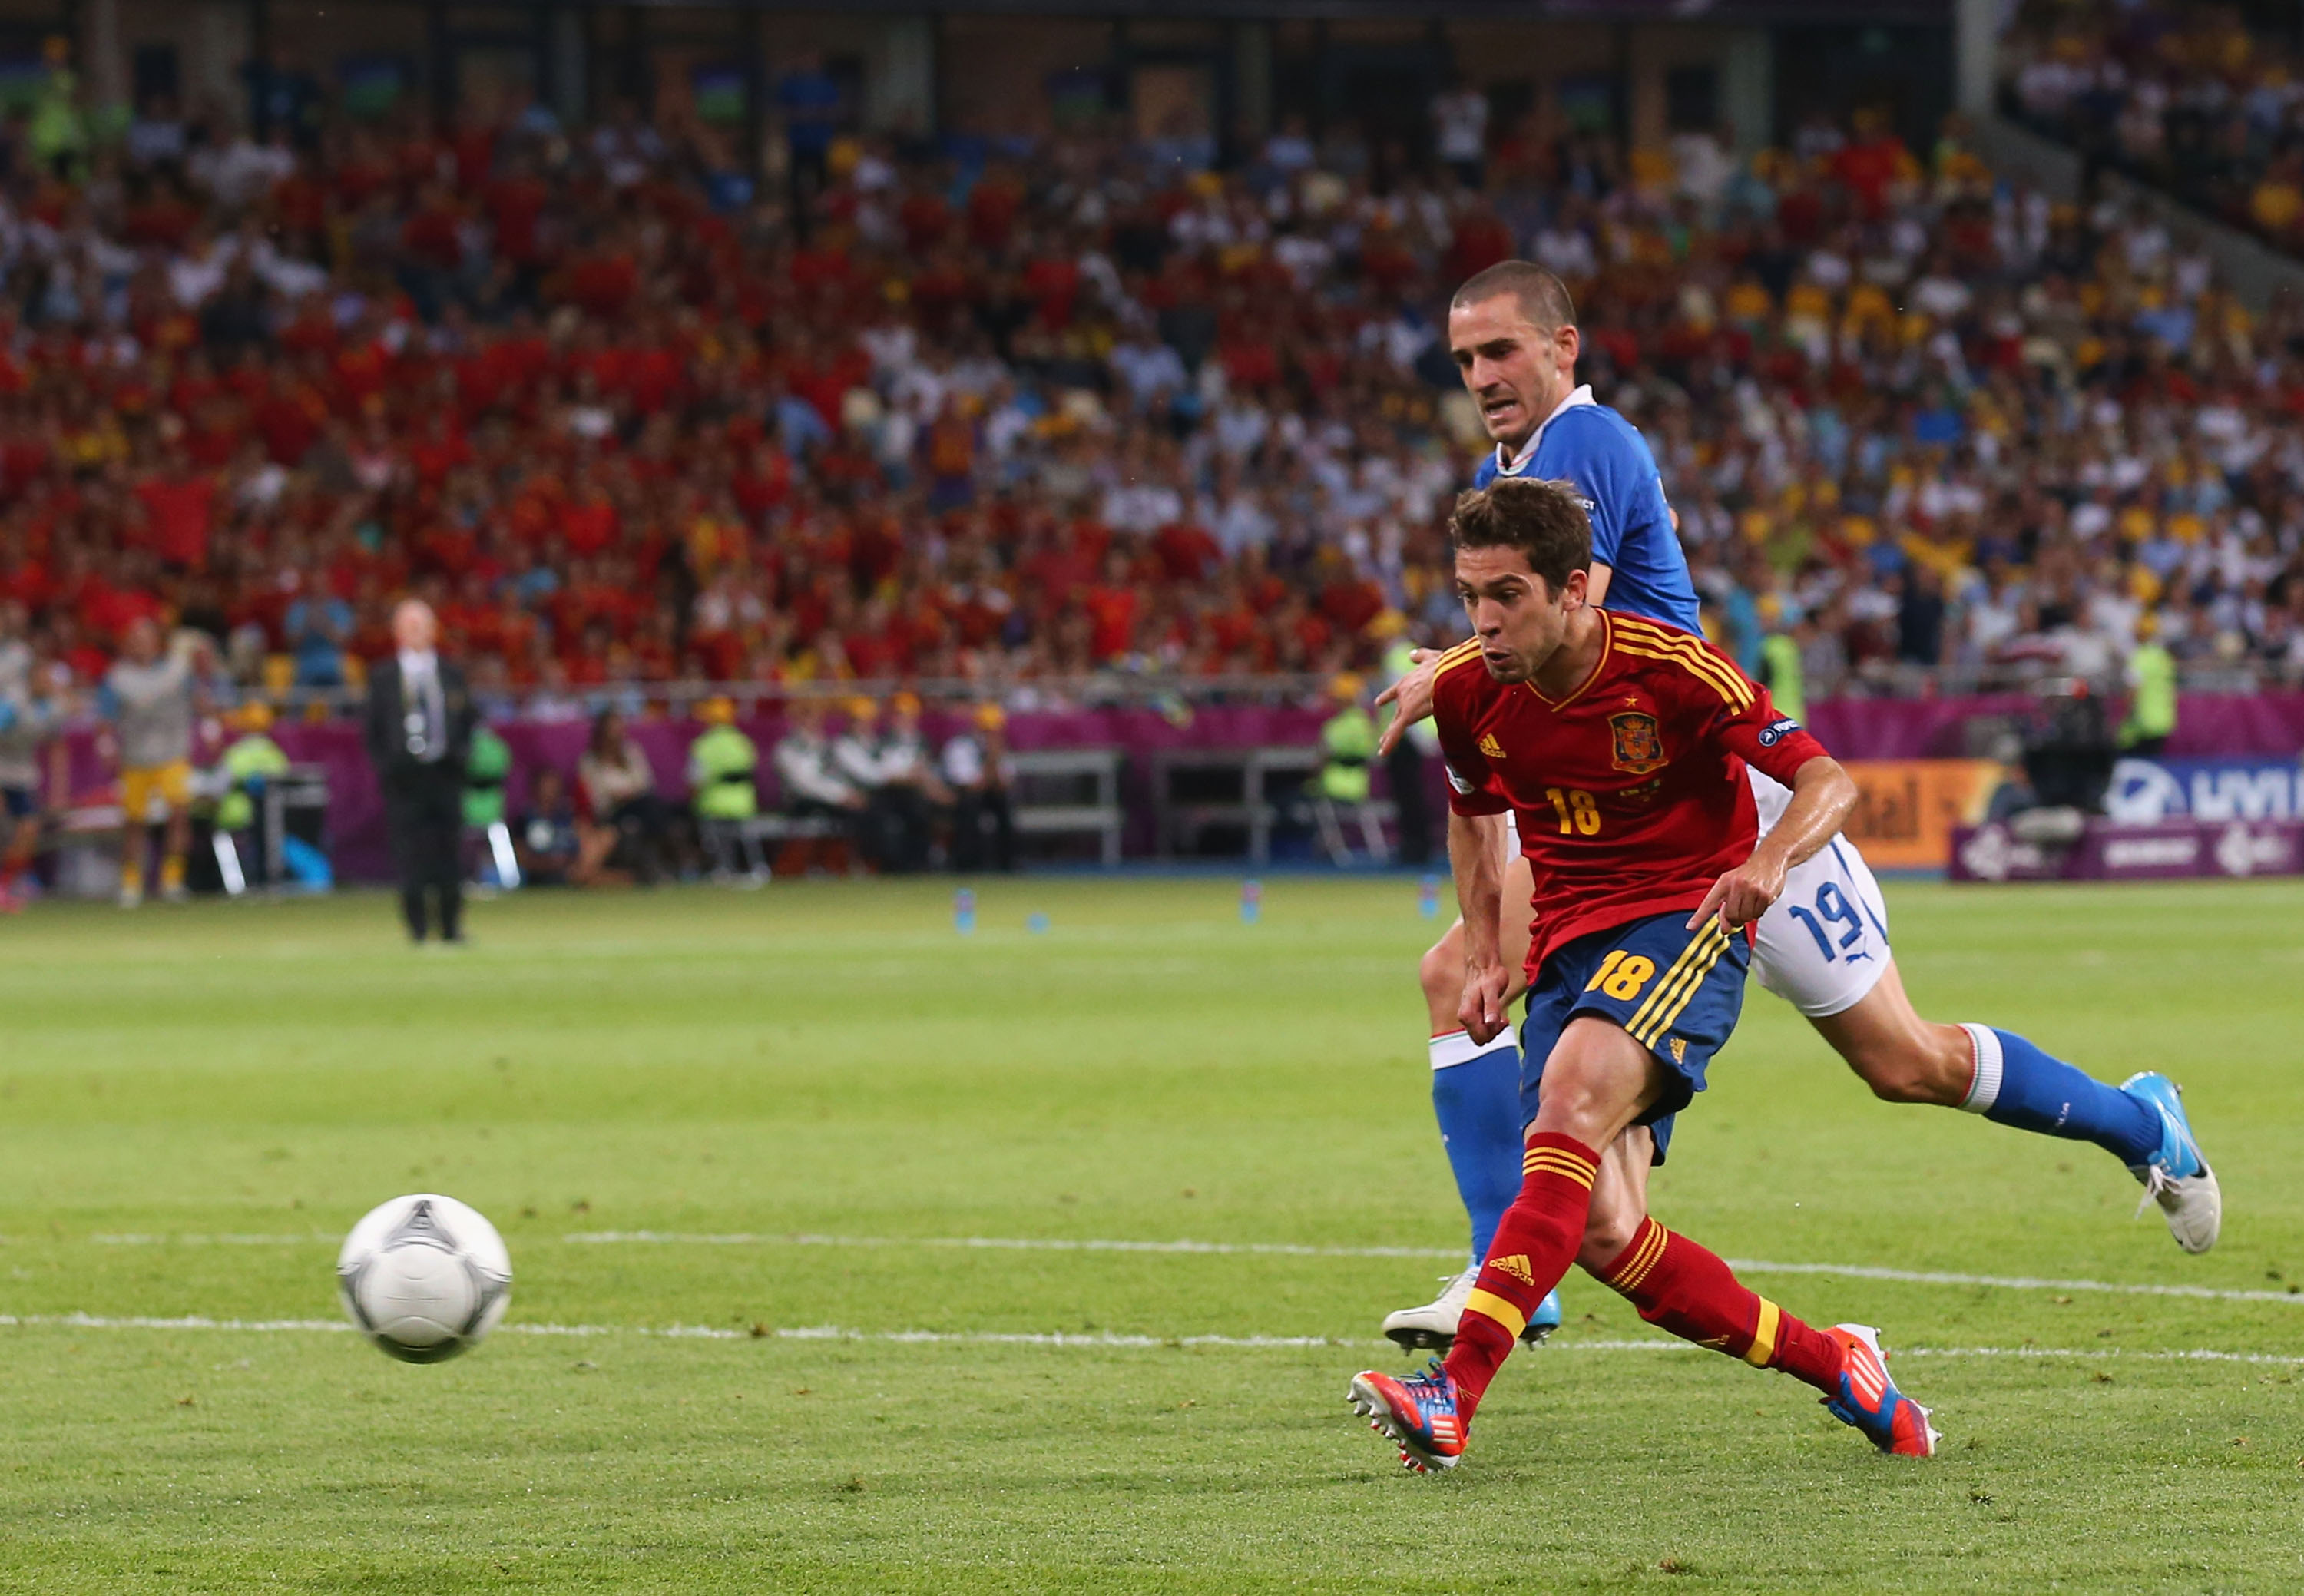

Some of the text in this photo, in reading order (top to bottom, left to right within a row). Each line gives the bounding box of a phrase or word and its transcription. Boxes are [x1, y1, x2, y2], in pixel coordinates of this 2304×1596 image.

[1546, 787, 1601, 836] 18
[1788, 881, 1863, 963] 19
[1584, 949, 1656, 1002] 18
[1488, 1260, 1534, 1286] adidas
